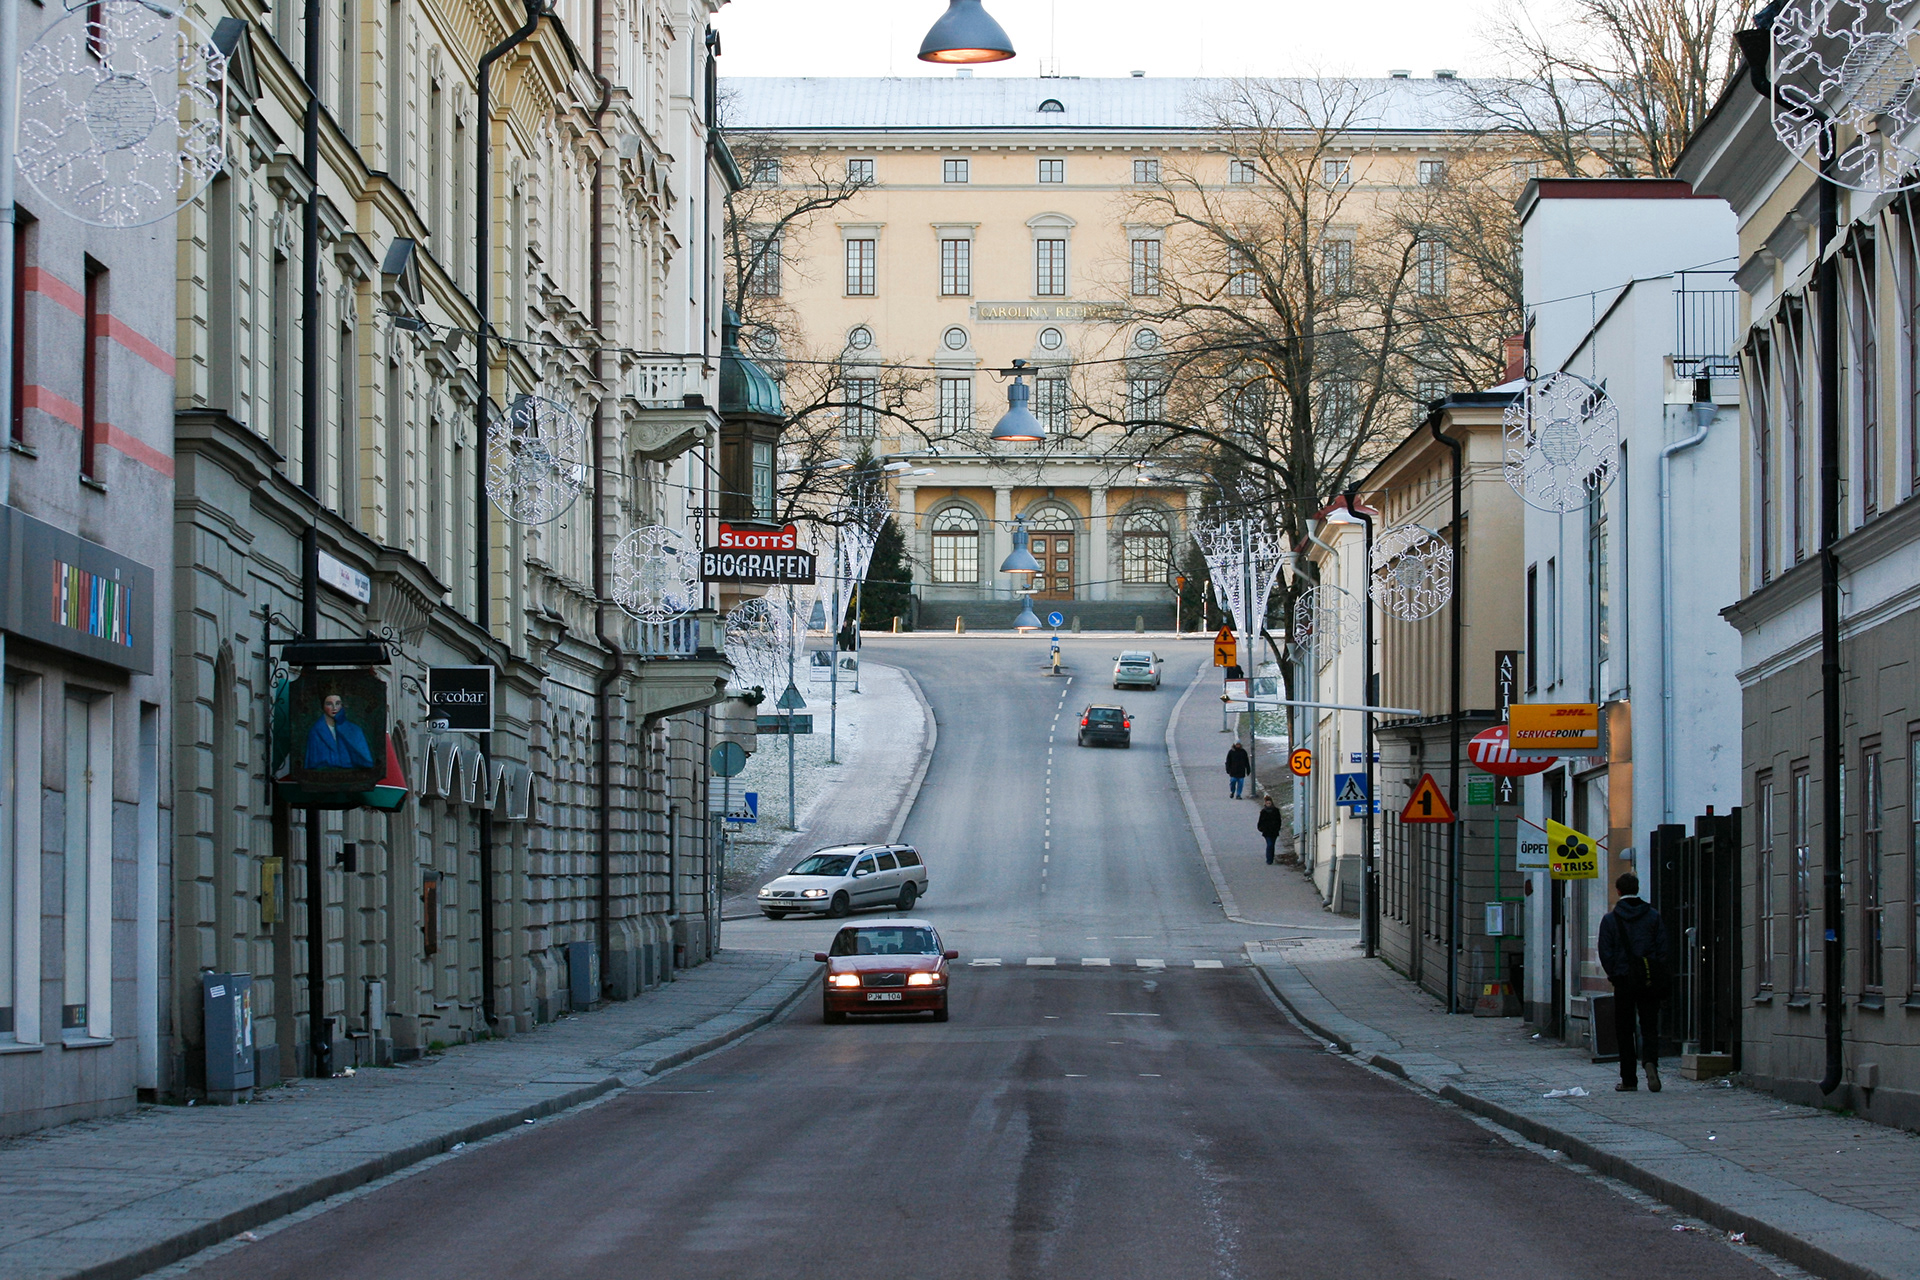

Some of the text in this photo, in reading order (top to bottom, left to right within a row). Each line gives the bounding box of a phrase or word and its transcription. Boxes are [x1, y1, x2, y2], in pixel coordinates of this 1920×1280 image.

[980, 306, 1049, 318] CAROLINA
[720, 532, 794, 548] SLOTTS
[704, 553, 810, 578] BIOGRAFEN
[52, 559, 133, 648] HEMMAKVÄLL
[434, 687, 484, 703] ecobar
[1554, 709, 1587, 717] DHL
[432, 721, 446, 729] D12
[1516, 729, 1586, 739] SERVICEPOINT
[1294, 755, 1311, 770] 50
[1521, 840, 1549, 854] ÖPPET
[1563, 861, 1594, 872] TRISS
